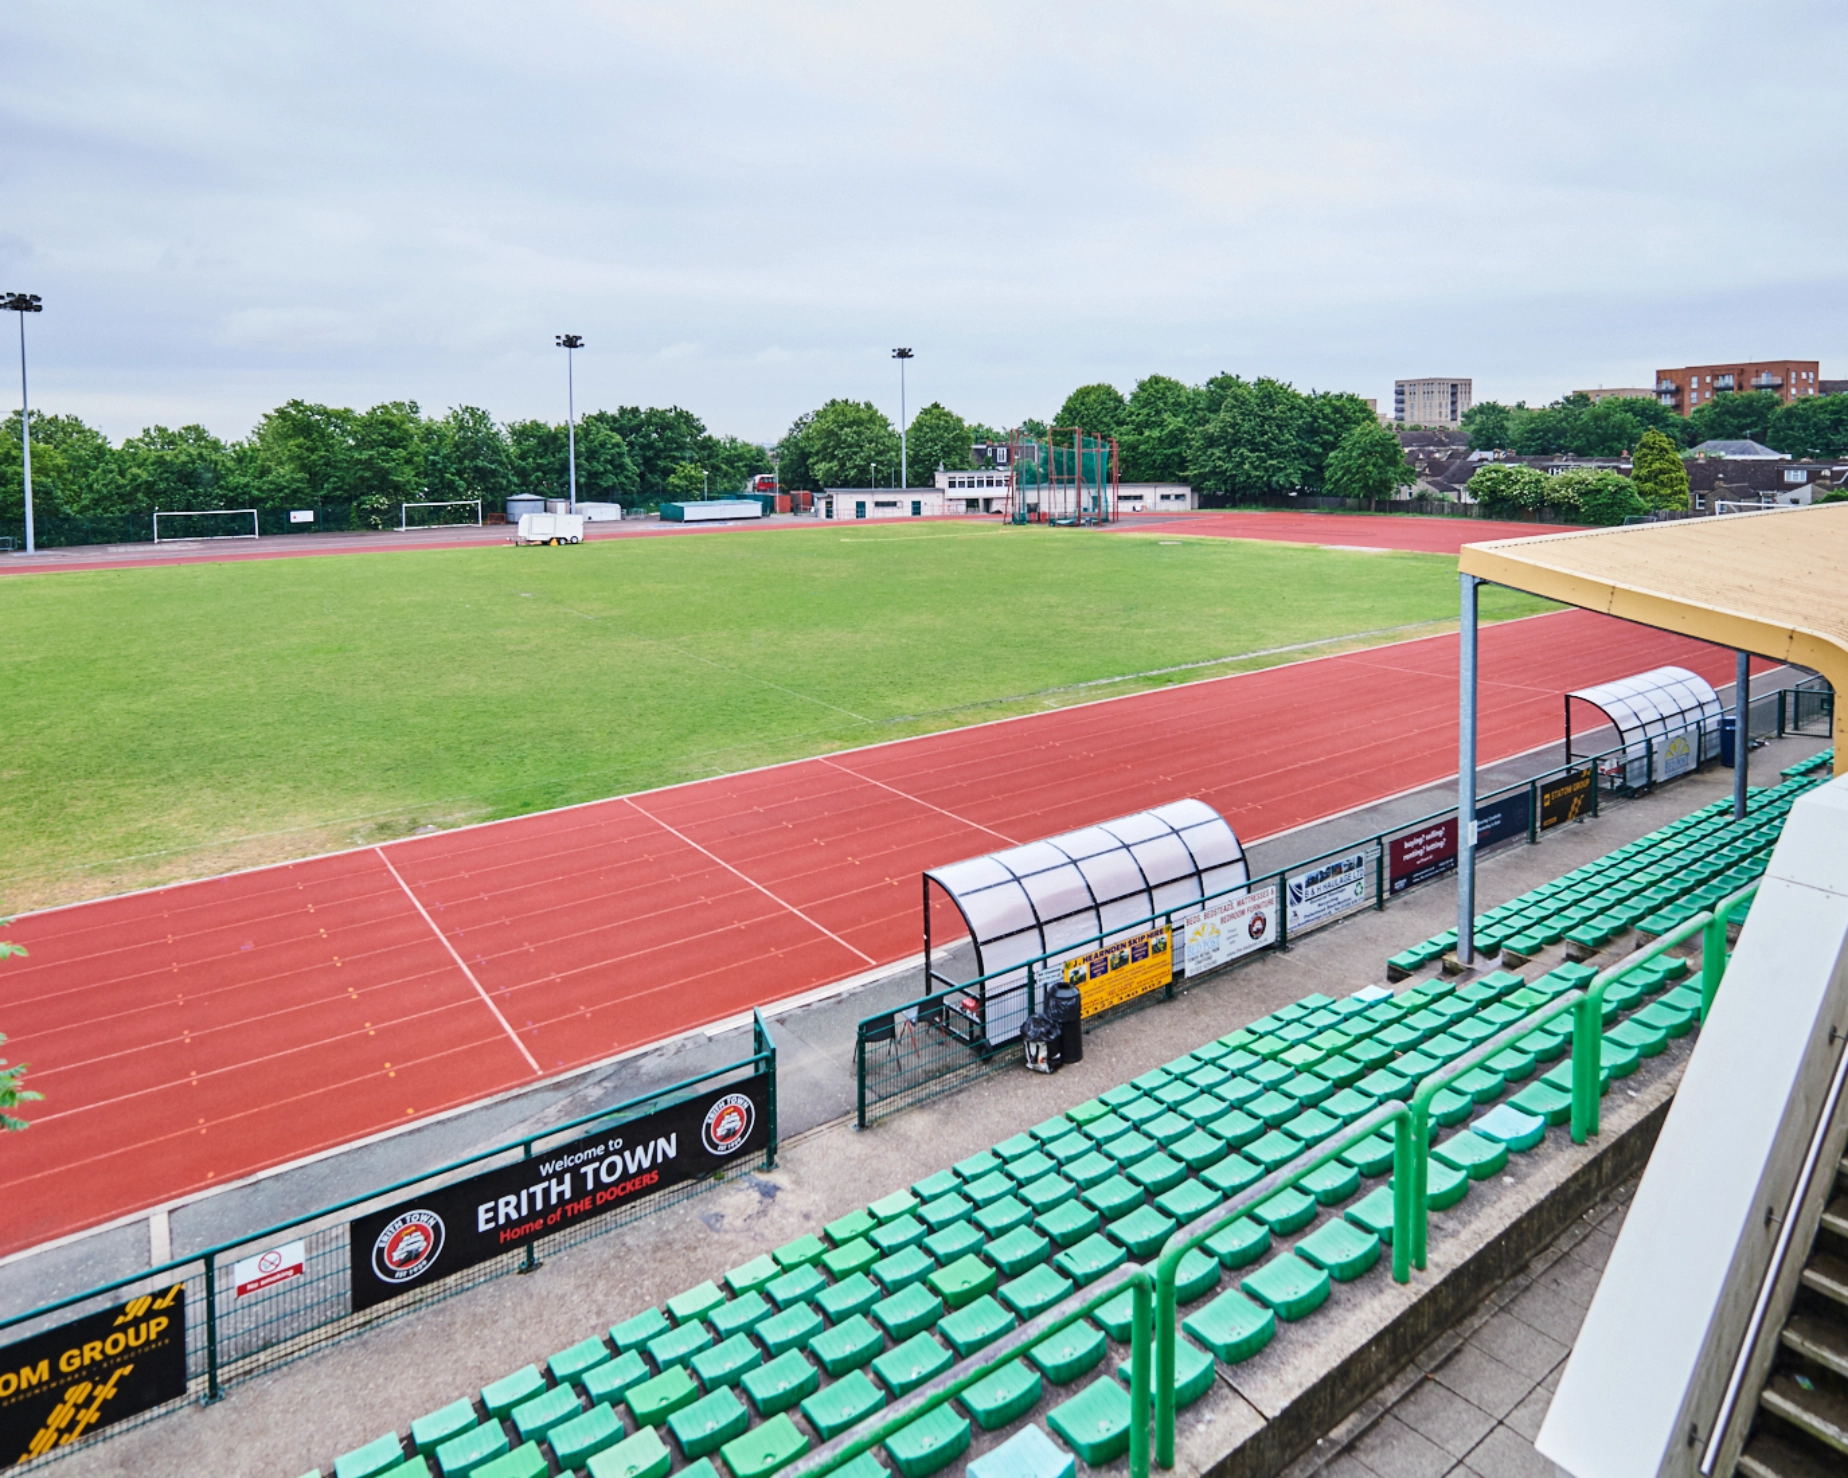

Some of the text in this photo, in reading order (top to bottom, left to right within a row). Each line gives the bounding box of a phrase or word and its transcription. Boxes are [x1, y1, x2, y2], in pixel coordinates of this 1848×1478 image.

[1551, 778, 1591, 800] STATOM GROUP
[1403, 845, 1426, 861] renting?
[1425, 837, 1447, 852] letting?
[1404, 826, 1446, 849] buying? selling?
[1236, 889, 1269, 907] MATTRESSES
[1270, 887, 1275, 896] &
[1304, 868, 1364, 899] B & H HAULAGE LTD
[1220, 908, 1246, 925] BEDROOM
[1246, 898, 1275, 914] FURNITURE
[1083, 943, 1127, 963] HEARNDEN
[1128, 935, 1146, 947] SKIP
[1147, 928, 1164, 939] HIRE
[706, 1096, 751, 1123] ERITH TOWN
[539, 1137, 623, 1177] Welcome to
[477, 1132, 677, 1233] ERITH TOWN
[499, 1169, 660, 1244] Home of THE DOCKERS
[378, 1213, 438, 1248] ERITH TOWN
[59, 1316, 169, 1373] GROUP
